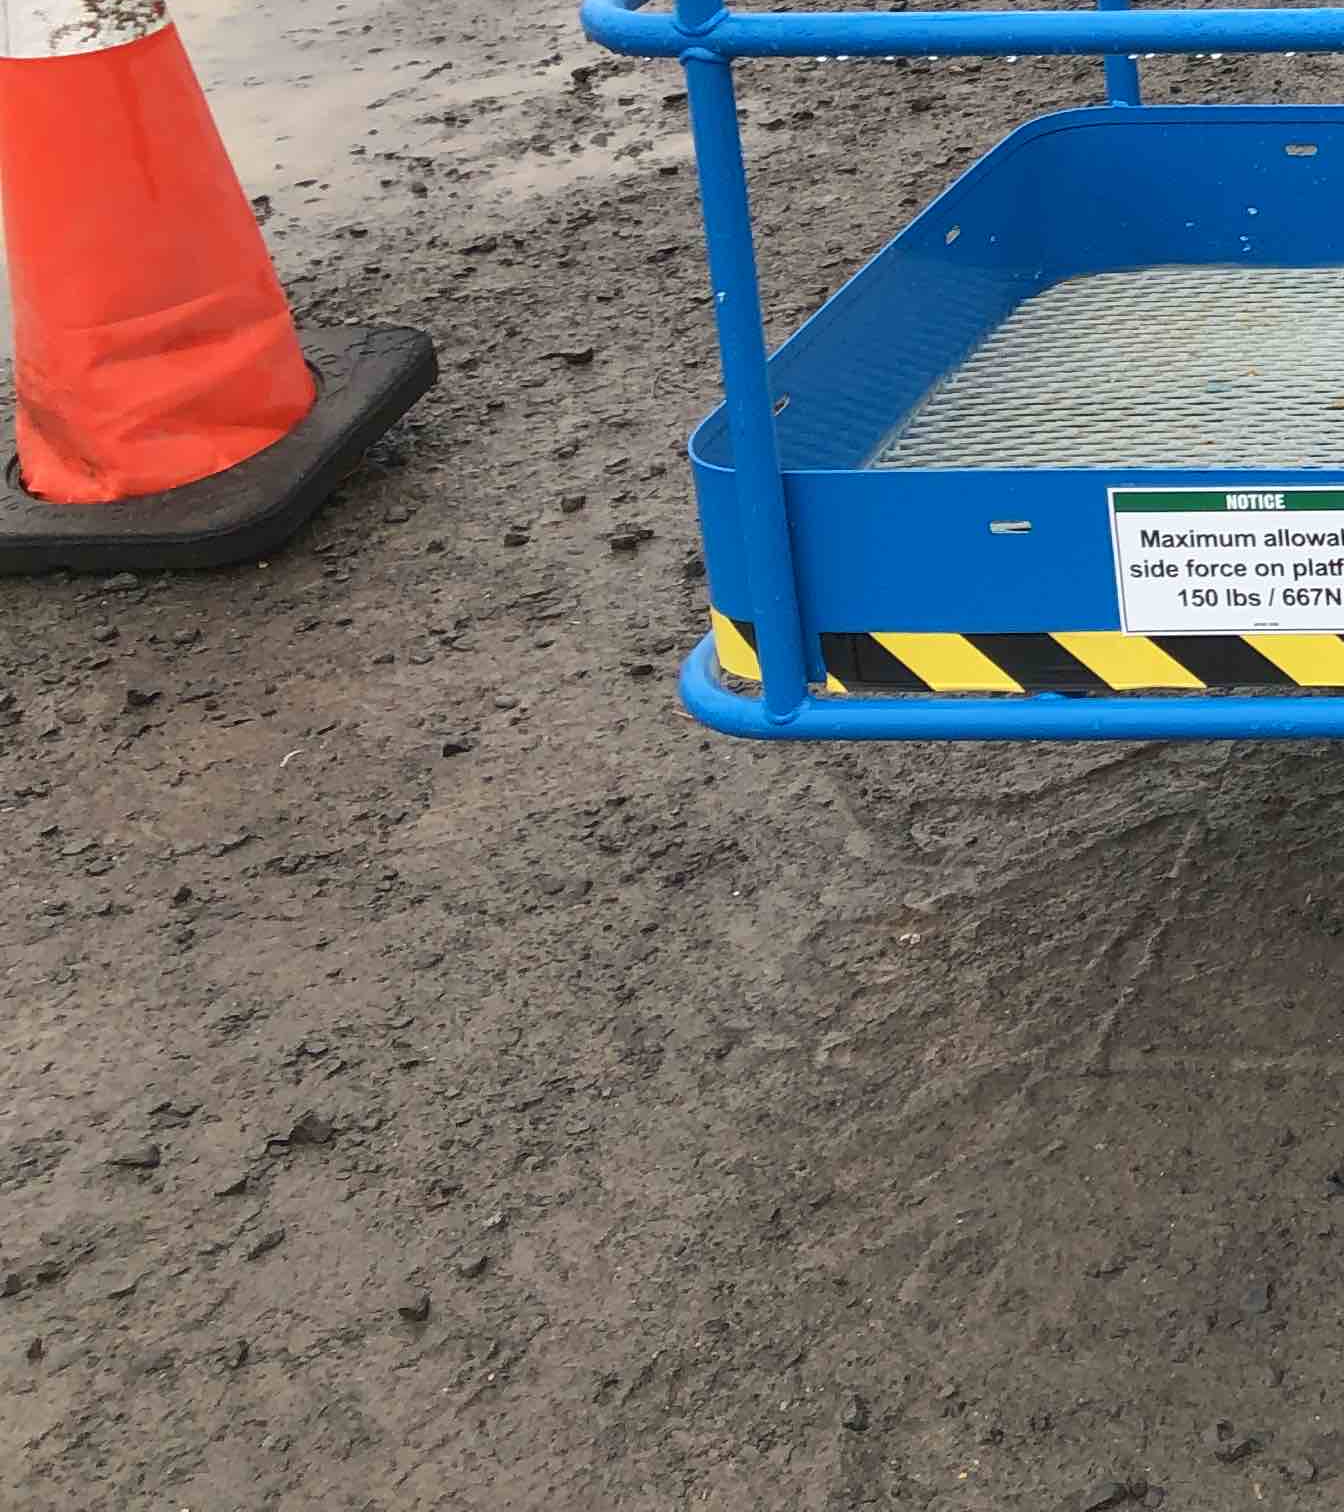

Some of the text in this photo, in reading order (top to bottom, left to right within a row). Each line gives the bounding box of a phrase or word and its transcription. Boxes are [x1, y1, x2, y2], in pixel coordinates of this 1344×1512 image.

[1226, 494, 1286, 510] NOTICE
[1141, 530, 1256, 548] Maximum
[1130, 560, 1178, 578] side
[1186, 558, 1246, 577] force
[1254, 563, 1285, 577] on
[1177, 589, 1218, 607] 150
[1226, 588, 1261, 607] lbs
[1268, 588, 1275, 607] /
